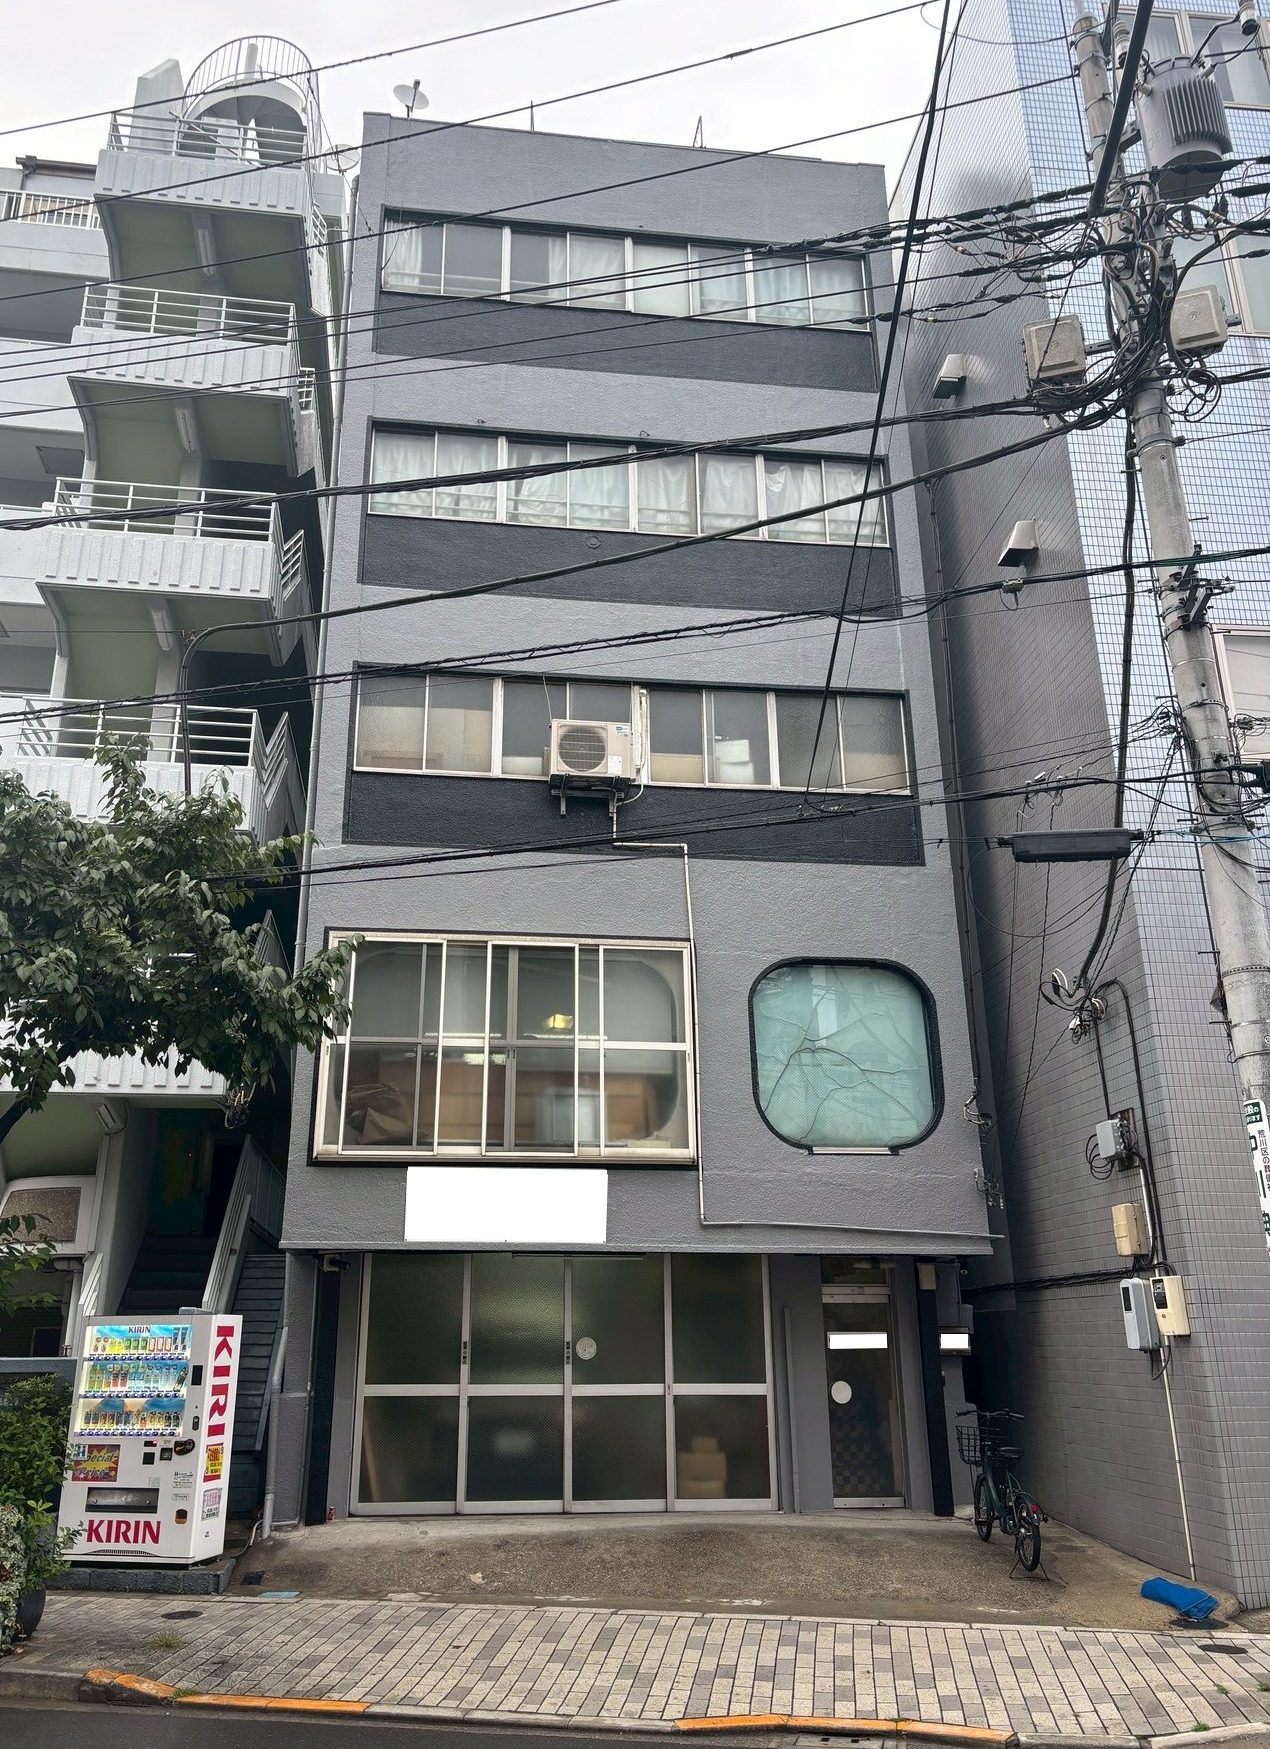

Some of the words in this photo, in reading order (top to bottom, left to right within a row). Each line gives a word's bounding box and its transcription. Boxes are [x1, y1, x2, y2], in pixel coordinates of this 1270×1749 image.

[128, 1326, 151, 1334] KIRIN
[203, 1325, 234, 1483] KIRI
[83, 1453, 114, 1464] pecial
[86, 1519, 161, 1545] KIRIN
